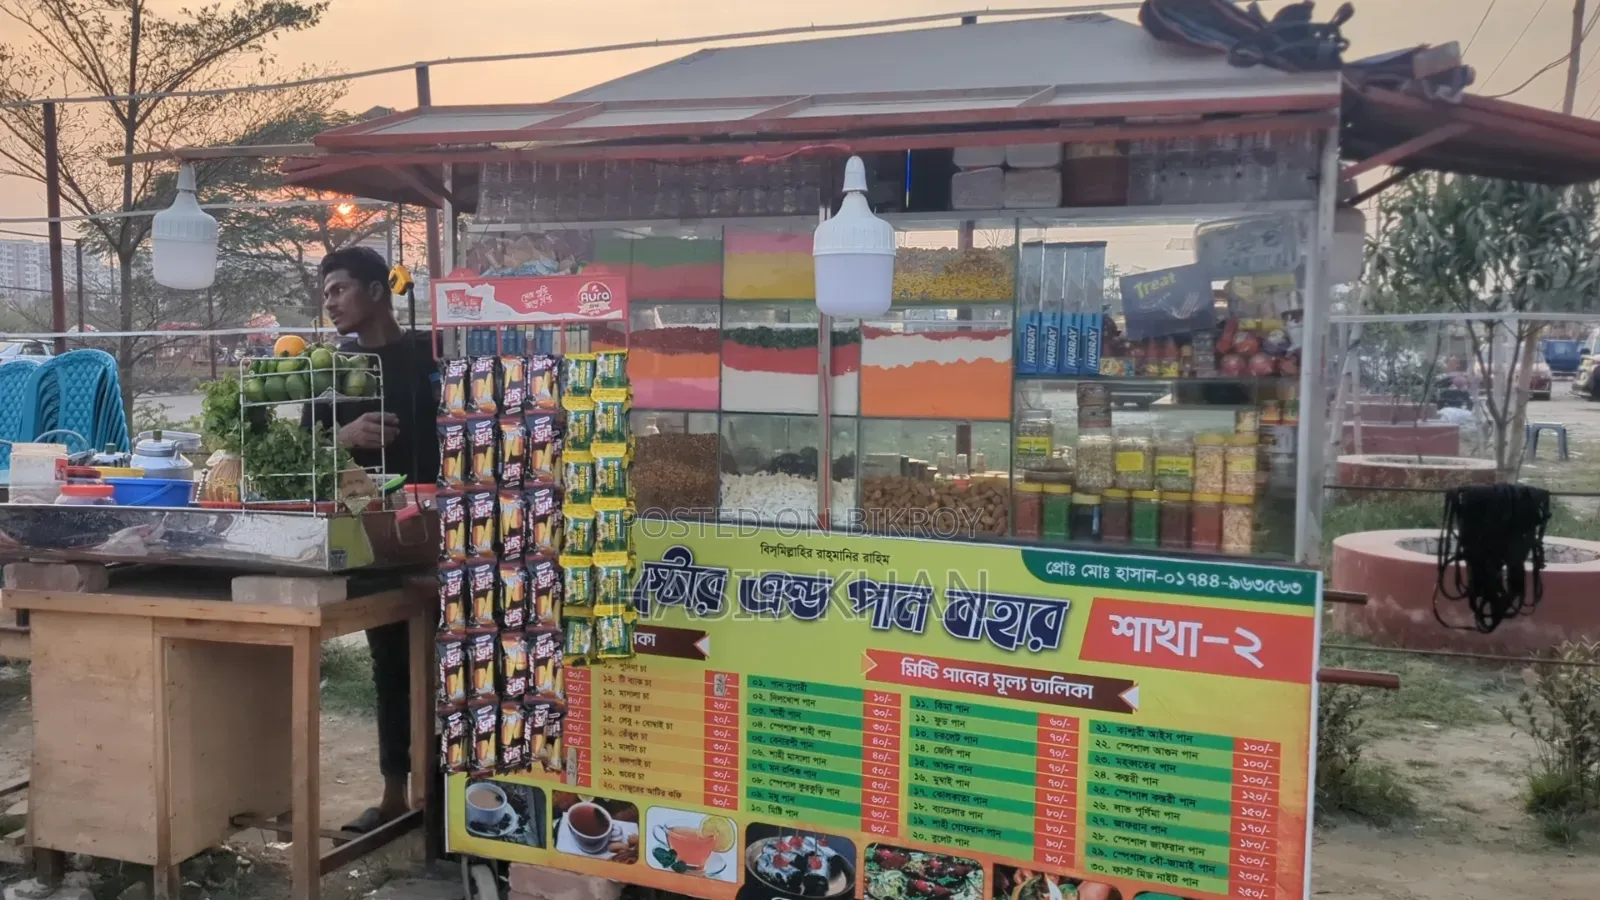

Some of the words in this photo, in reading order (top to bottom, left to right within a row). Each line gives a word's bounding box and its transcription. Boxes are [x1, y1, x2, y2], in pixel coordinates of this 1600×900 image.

[1133, 271, 1177, 299] Treat
[580, 291, 610, 302] Aura
[1026, 323, 1038, 366] HURRAY
[1046, 325, 1059, 367] HURRAY
[1066, 327, 1079, 368] HURRAY
[1087, 327, 1099, 368] HURRAY
[862, 550, 890, 565] রাহিম
[1081, 563, 1110, 580] মোঃ
[849, 578, 930, 636] পান
[943, 590, 1070, 652] বাহার
[1108, 613, 1265, 669] শাখা-২
[900, 657, 939, 680] মিষ্টি
[943, 668, 990, 690] পানের
[994, 672, 1028, 696] মূল্য
[1031, 677, 1095, 700] তালিকা
[801, 698, 816, 706] পান
[954, 704, 970, 713] পান
[950, 719, 965, 728] পান
[817, 729, 831, 737] পান
[1175, 733, 1193, 743] পান
[963, 735, 978, 744] পান
[933, 745, 953, 756] জেলি
[955, 749, 971, 758] পান
[1243, 742, 1274, 754] ১০০/-
[812, 756, 826, 765] পান
[1181, 750, 1198, 759] পান
[956, 764, 972, 773] পান
[1158, 763, 1176, 772] পান
[1242, 758, 1273, 770] ১০০/-
[954, 779, 970, 788] পান
[1141, 776, 1159, 786] পান
[1242, 774, 1273, 788] ১০০/-
[825, 787, 840, 796] পান
[1242, 790, 1272, 802] ১২০/-
[972, 796, 988, 804] পান
[1178, 797, 1196, 807] পান
[968, 810, 983, 819] পান
[1113, 803, 1132, 813] লাভ
[1163, 811, 1180, 820] পান
[1241, 806, 1271, 819] ১৫০/-
[986, 828, 1001, 837] পান
[1150, 824, 1167, 834] পান
[1240, 822, 1271, 834] ১৭০/-
[930, 834, 952, 843] বুলেট
[954, 838, 970, 846] পান
[1240, 838, 1270, 851] ১৮০/-
[1187, 846, 1205, 856] পান
[1238, 853, 1269, 867] ২০০/-
[1197, 864, 1216, 873] পান
[1155, 871, 1178, 884] নাইট
[1181, 877, 1199, 886] পান
[1238, 870, 1269, 883] ২০০/-
[1238, 886, 1268, 899] ২৫০/-
